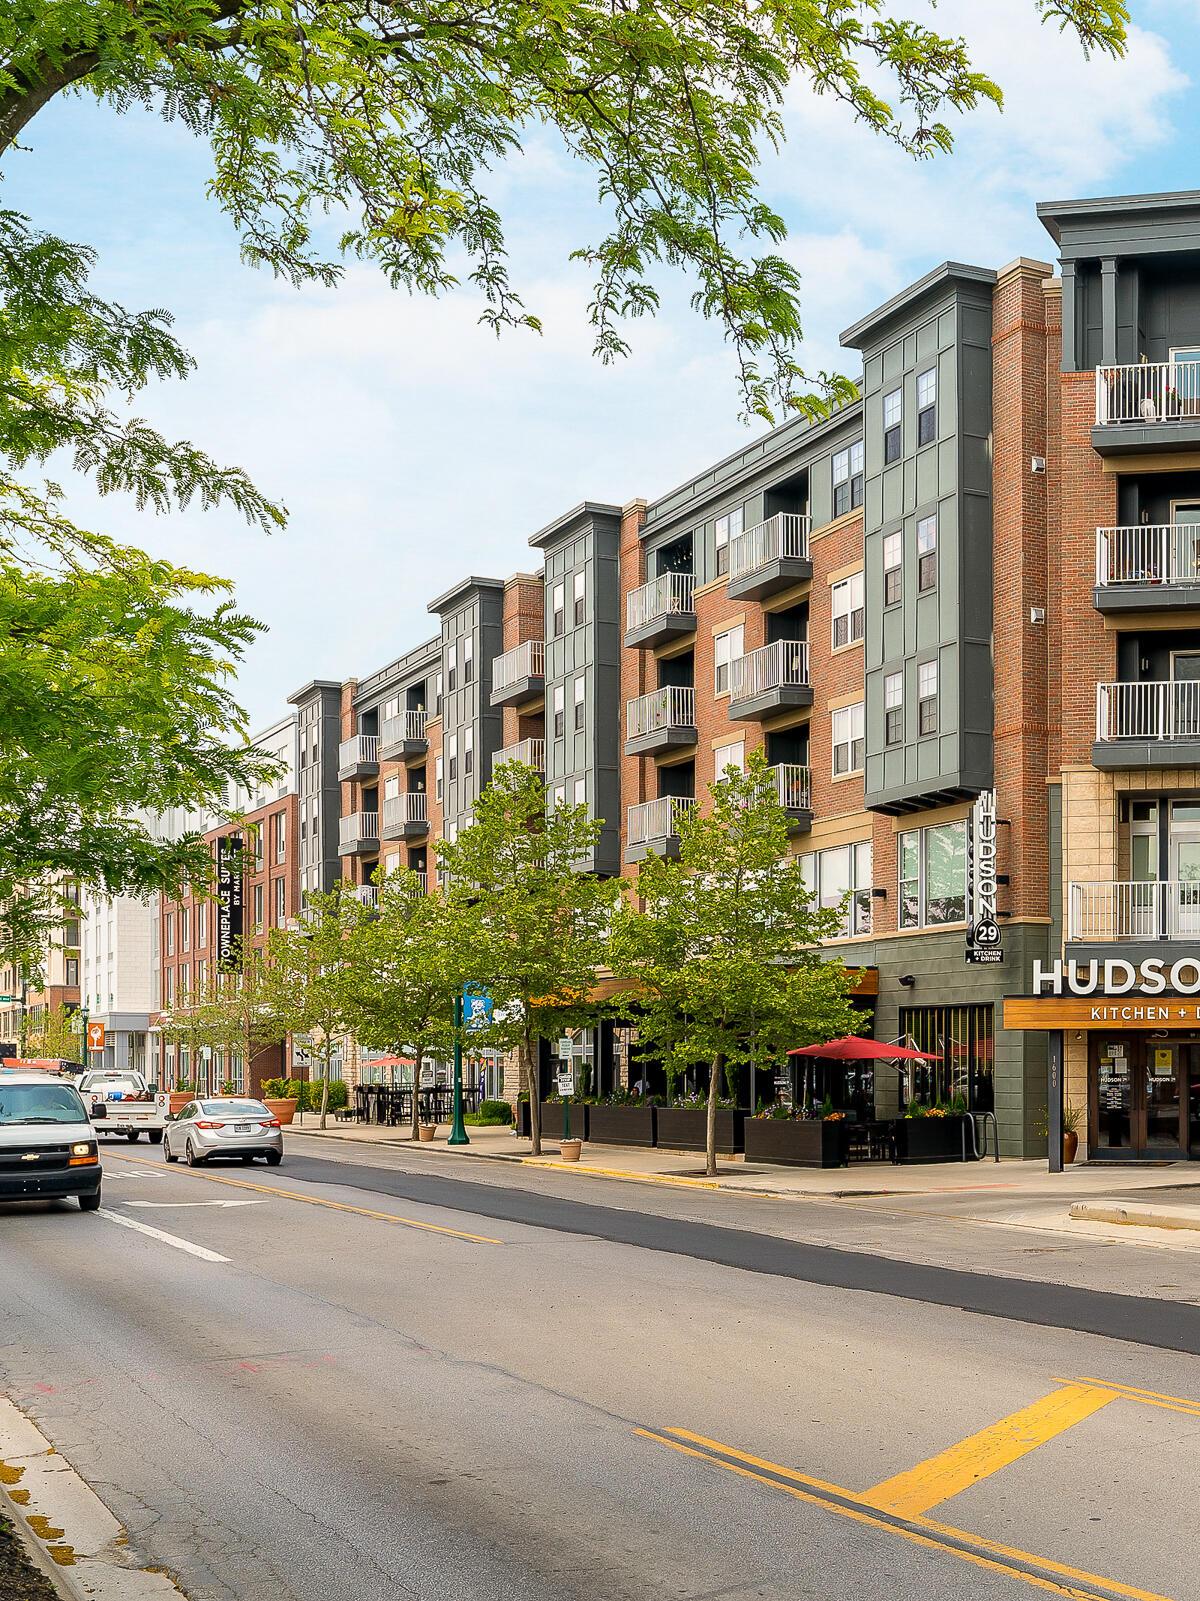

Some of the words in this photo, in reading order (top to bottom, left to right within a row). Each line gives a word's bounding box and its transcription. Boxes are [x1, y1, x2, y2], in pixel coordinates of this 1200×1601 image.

[977, 806, 998, 915] HUDSON
[233, 894, 241, 906] BY
[978, 925, 998, 941] 29
[1090, 1006, 1170, 1021] KITCHEN
